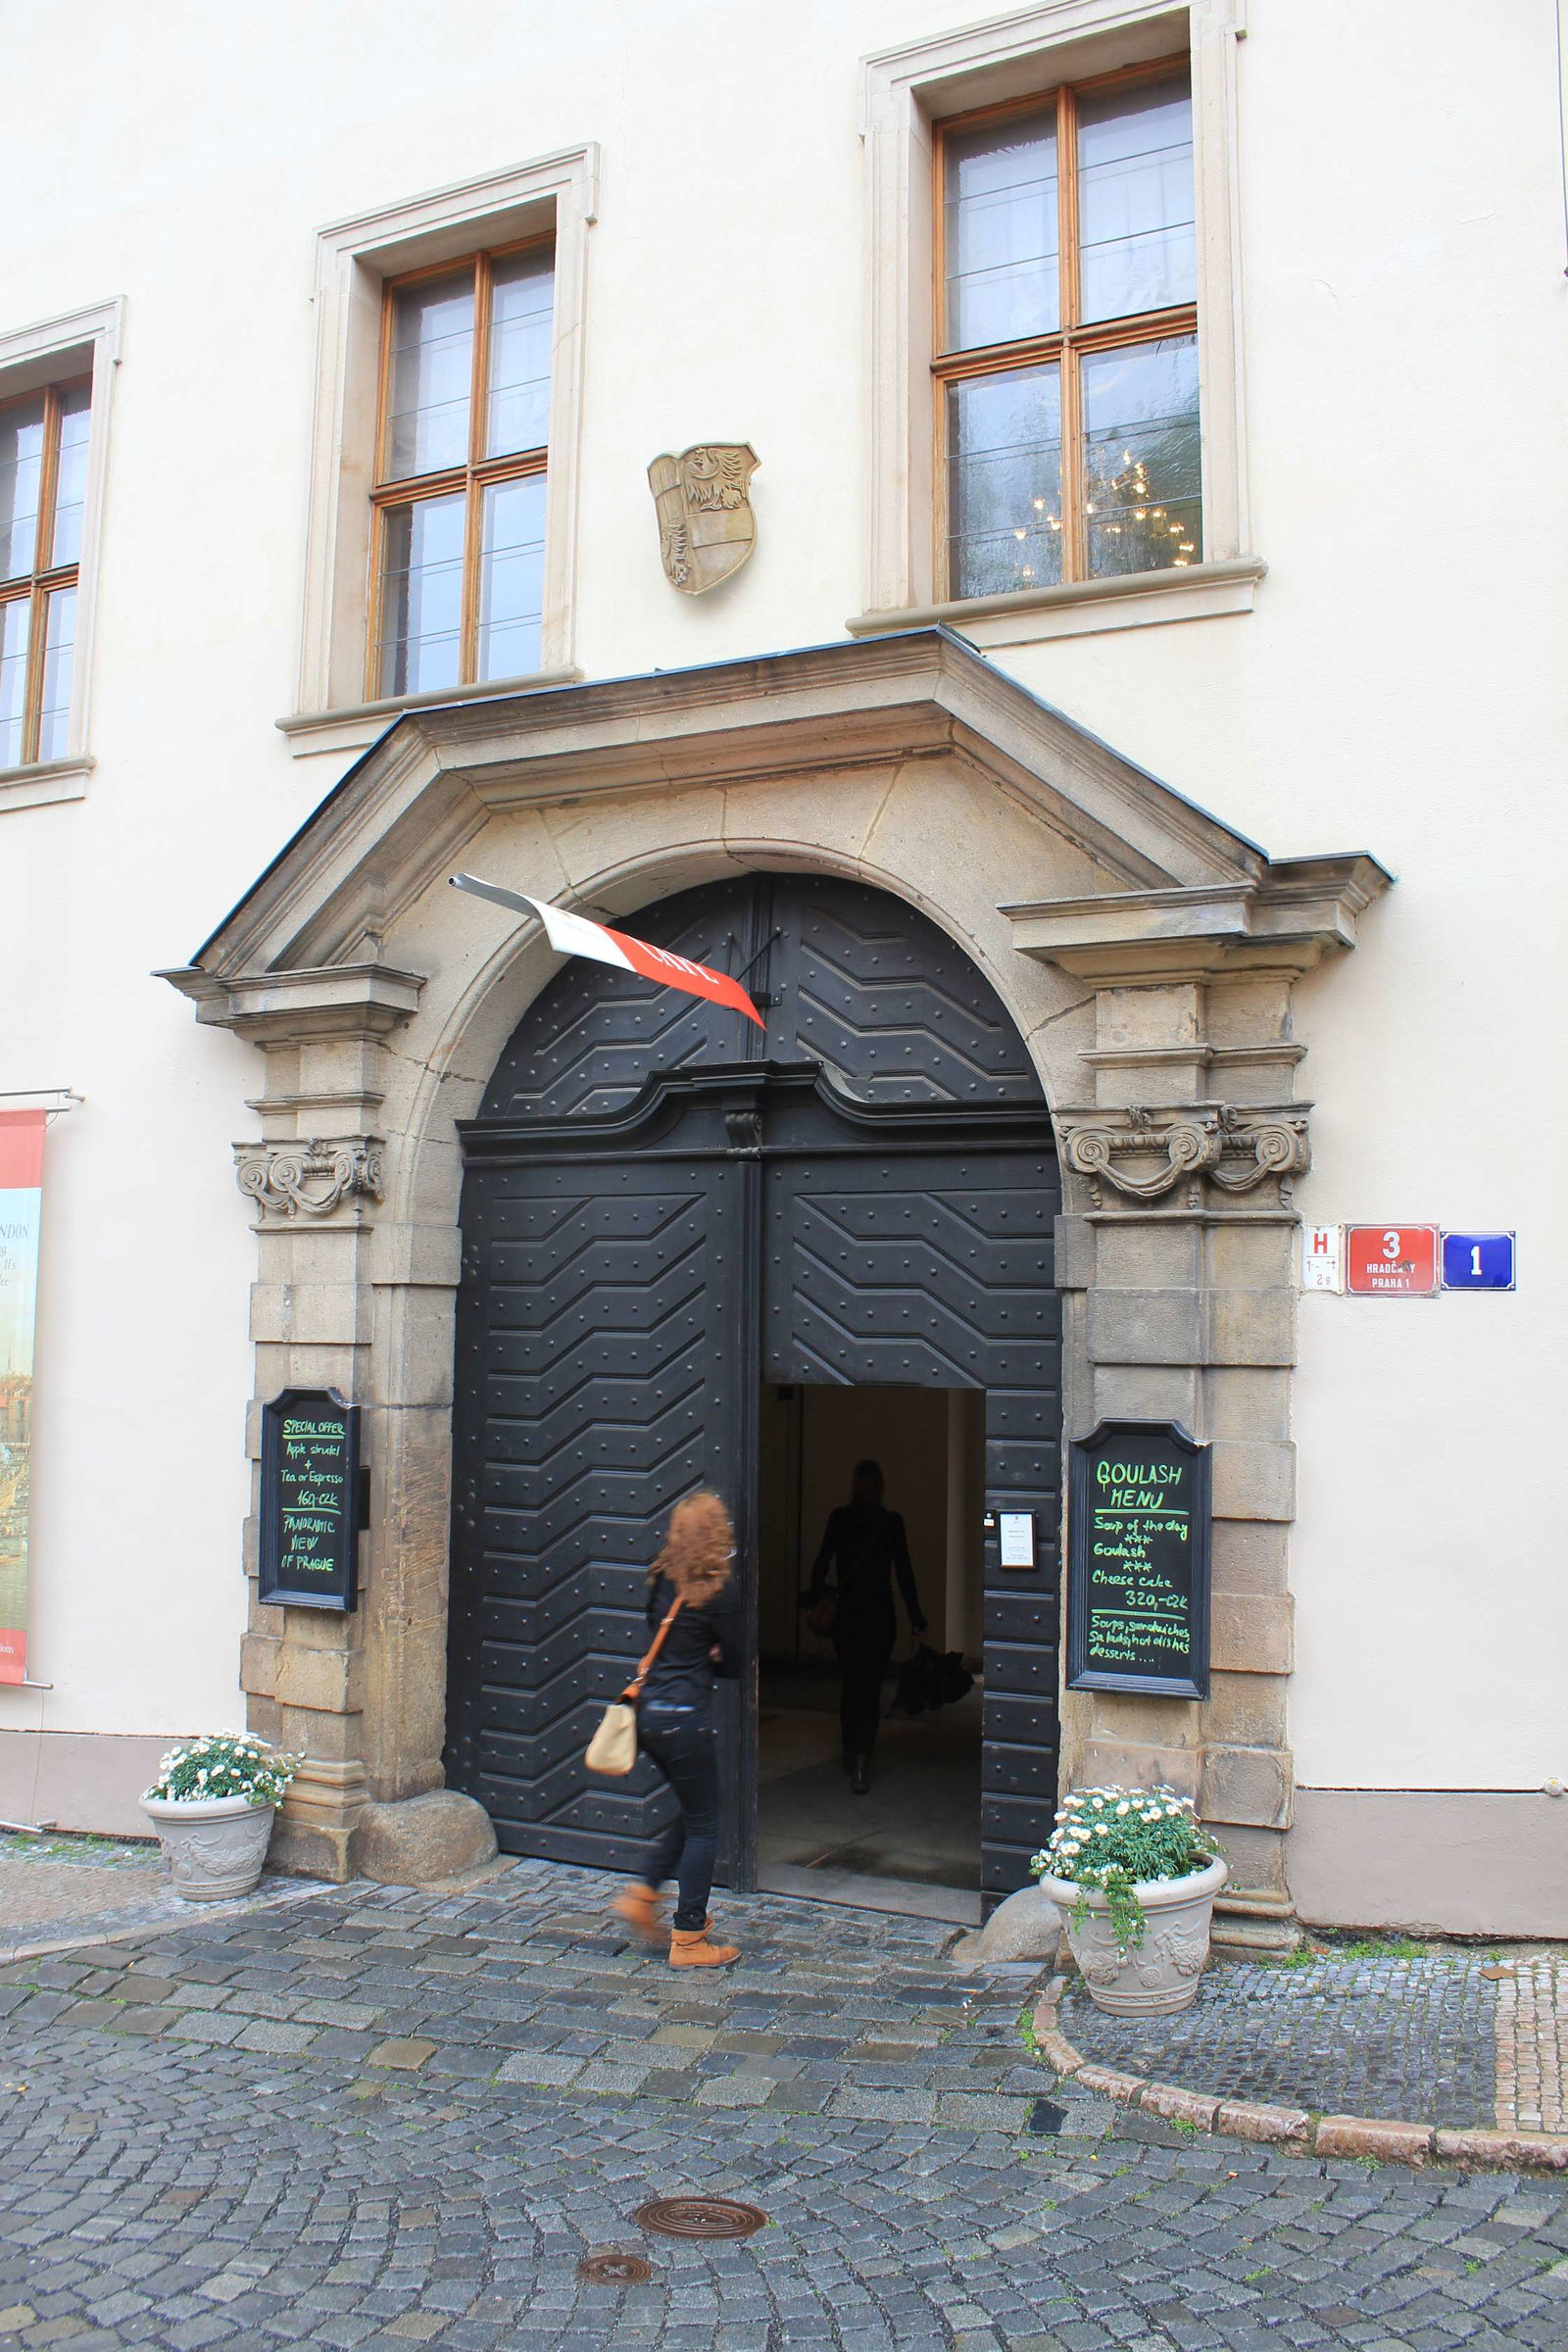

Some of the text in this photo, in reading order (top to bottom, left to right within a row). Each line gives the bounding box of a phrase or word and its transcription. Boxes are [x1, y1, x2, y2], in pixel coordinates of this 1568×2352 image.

[1314, 1233, 1328, 1254] H
[1382, 1231, 1400, 1259] 3
[1470, 1246, 1483, 1276] 1
[1372, 1278, 1410, 1289] PRAHA 1
[283, 1419, 346, 1436] SPECIAL OFFER
[286, 1441, 340, 1460] Apple strudel
[280, 1469, 344, 1487] Tea or Espresso
[1097, 1460, 1183, 1487] GOULASH
[1110, 1488, 1164, 1509] MENU
[283, 1514, 336, 1534] PANORAMIC
[1094, 1516, 1189, 1542] Soup of the day
[1094, 1542, 1147, 1558] Goulash
[281, 1554, 334, 1572] OF PRAGUE
[1092, 1569, 1173, 1588] Cheese cake
